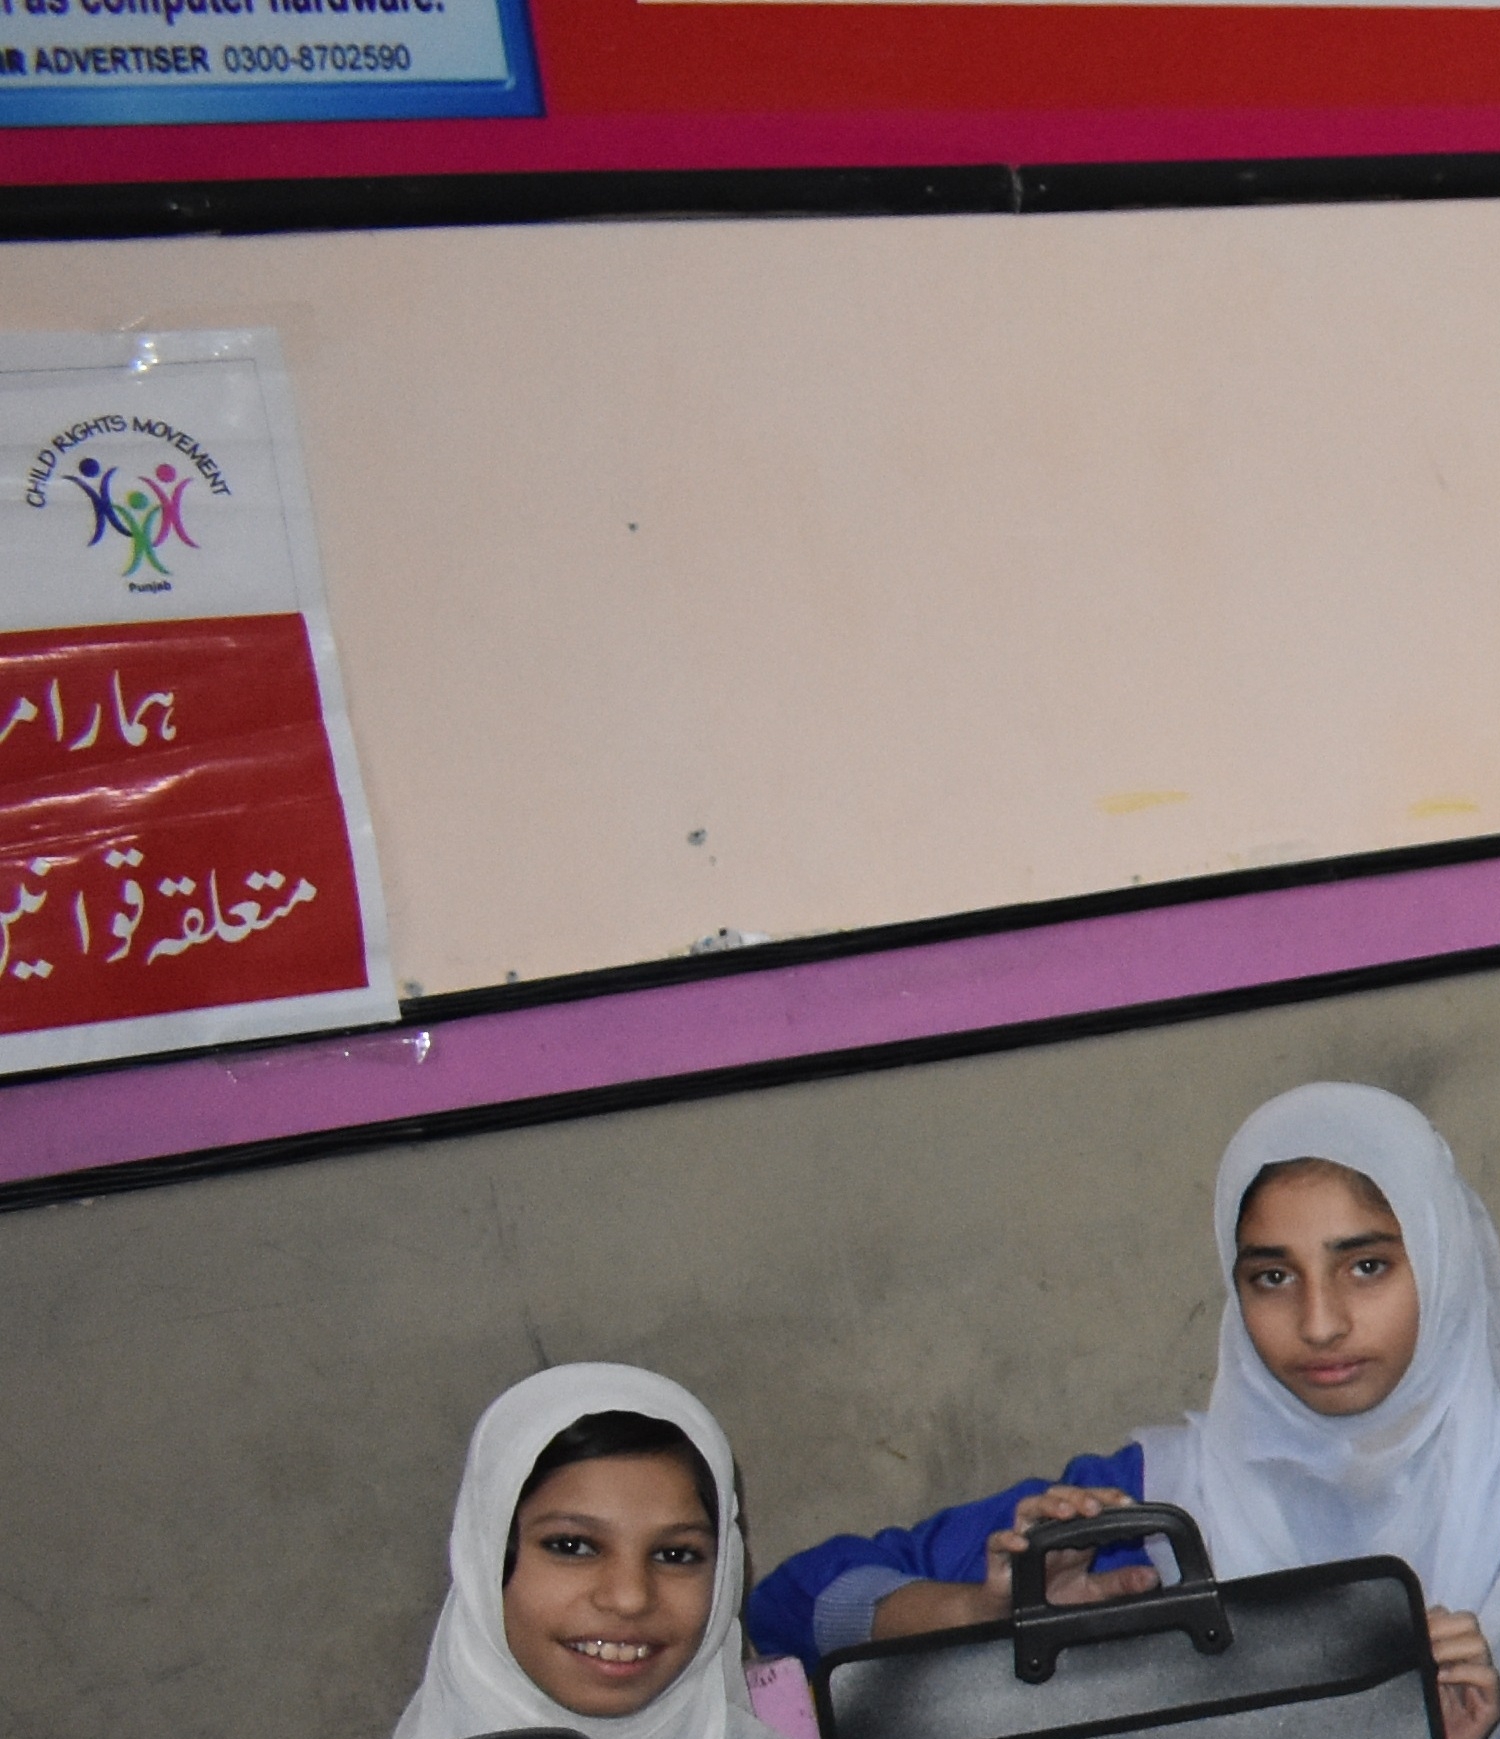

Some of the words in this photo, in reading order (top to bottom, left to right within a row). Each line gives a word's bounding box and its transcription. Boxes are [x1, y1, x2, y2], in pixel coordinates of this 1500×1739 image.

[35, 44, 211, 74] ADVERTISER
[223, 43, 412, 73] 0300-8702590
[26, 449, 57, 508] CHILD
[52, 414, 128, 455] RIGHTS
[132, 415, 232, 497] MOVEMENT
[128, 580, 172, 594] Punjab
[50, 669, 177, 752] ہمارا
[146, 868, 318, 967] متعلقہ
